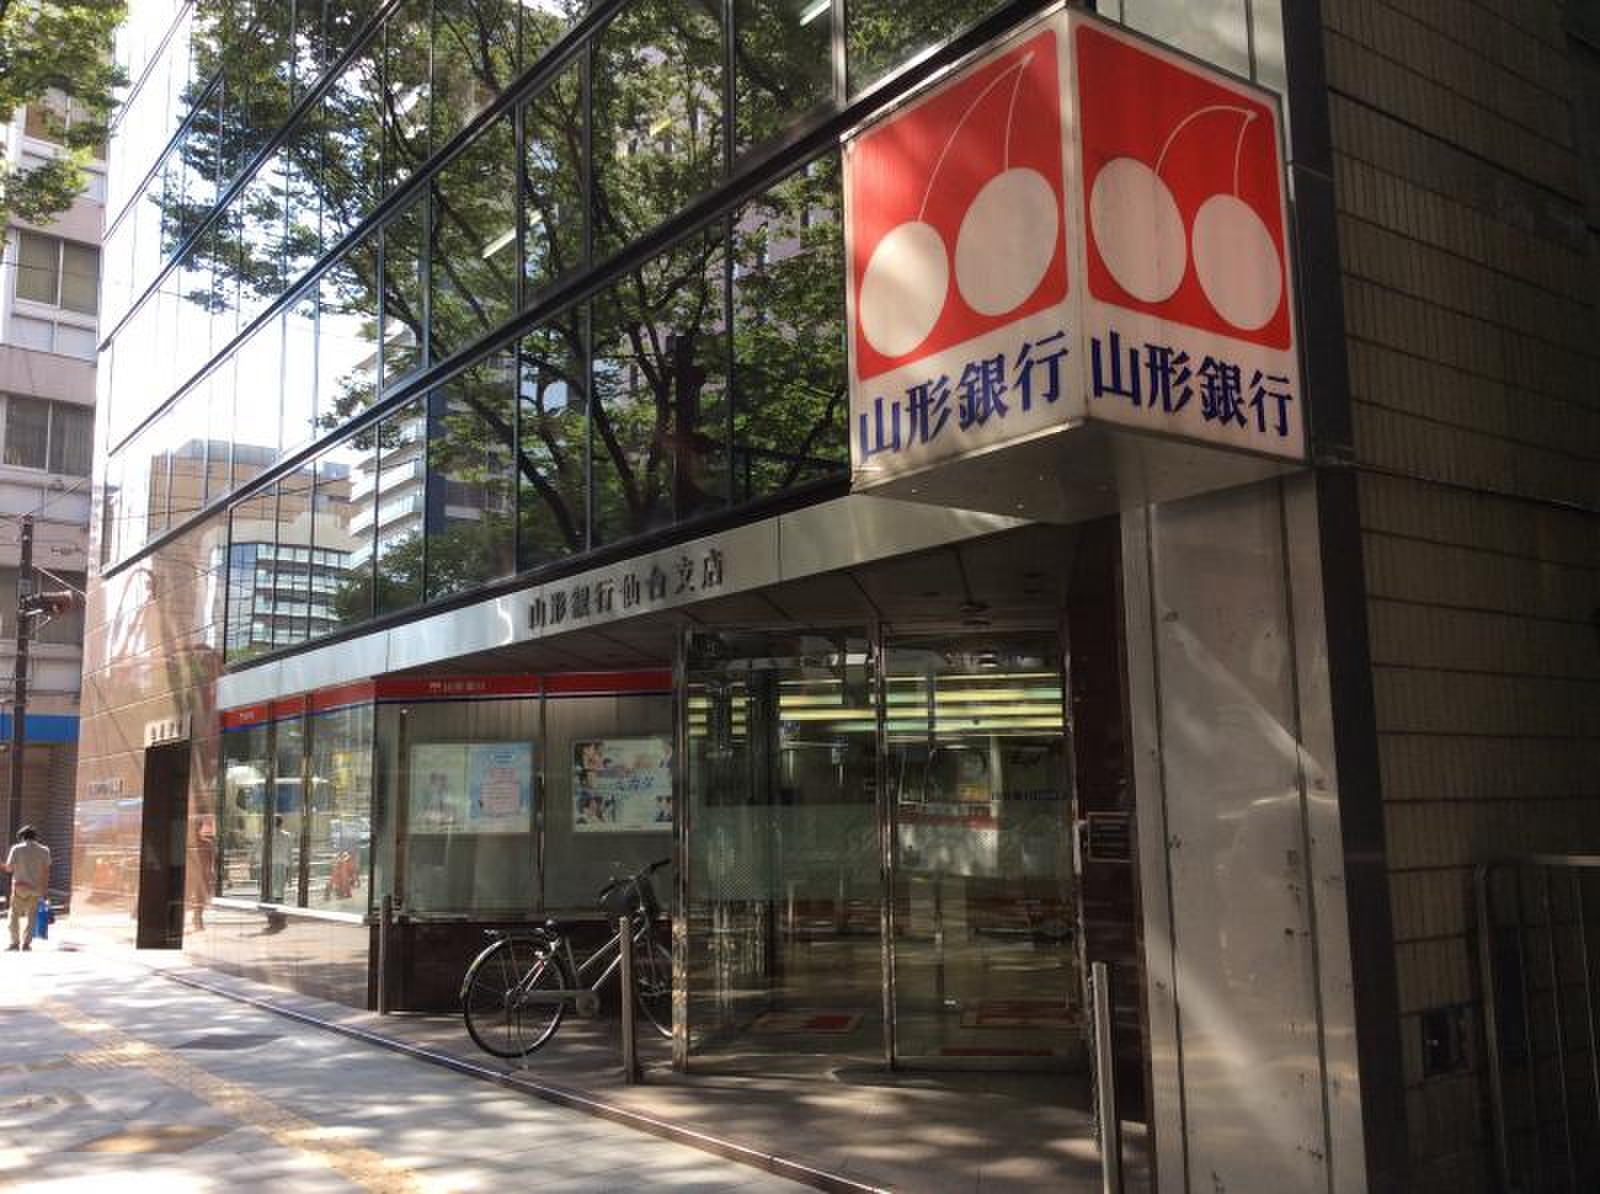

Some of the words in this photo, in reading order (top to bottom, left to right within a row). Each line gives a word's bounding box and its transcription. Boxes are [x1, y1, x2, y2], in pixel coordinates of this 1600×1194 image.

[858, 330, 1069, 461] 山形銀行
[1091, 330, 1295, 437] 山形銀行
[529, 548, 724, 630] 山形銀行仙台支店
